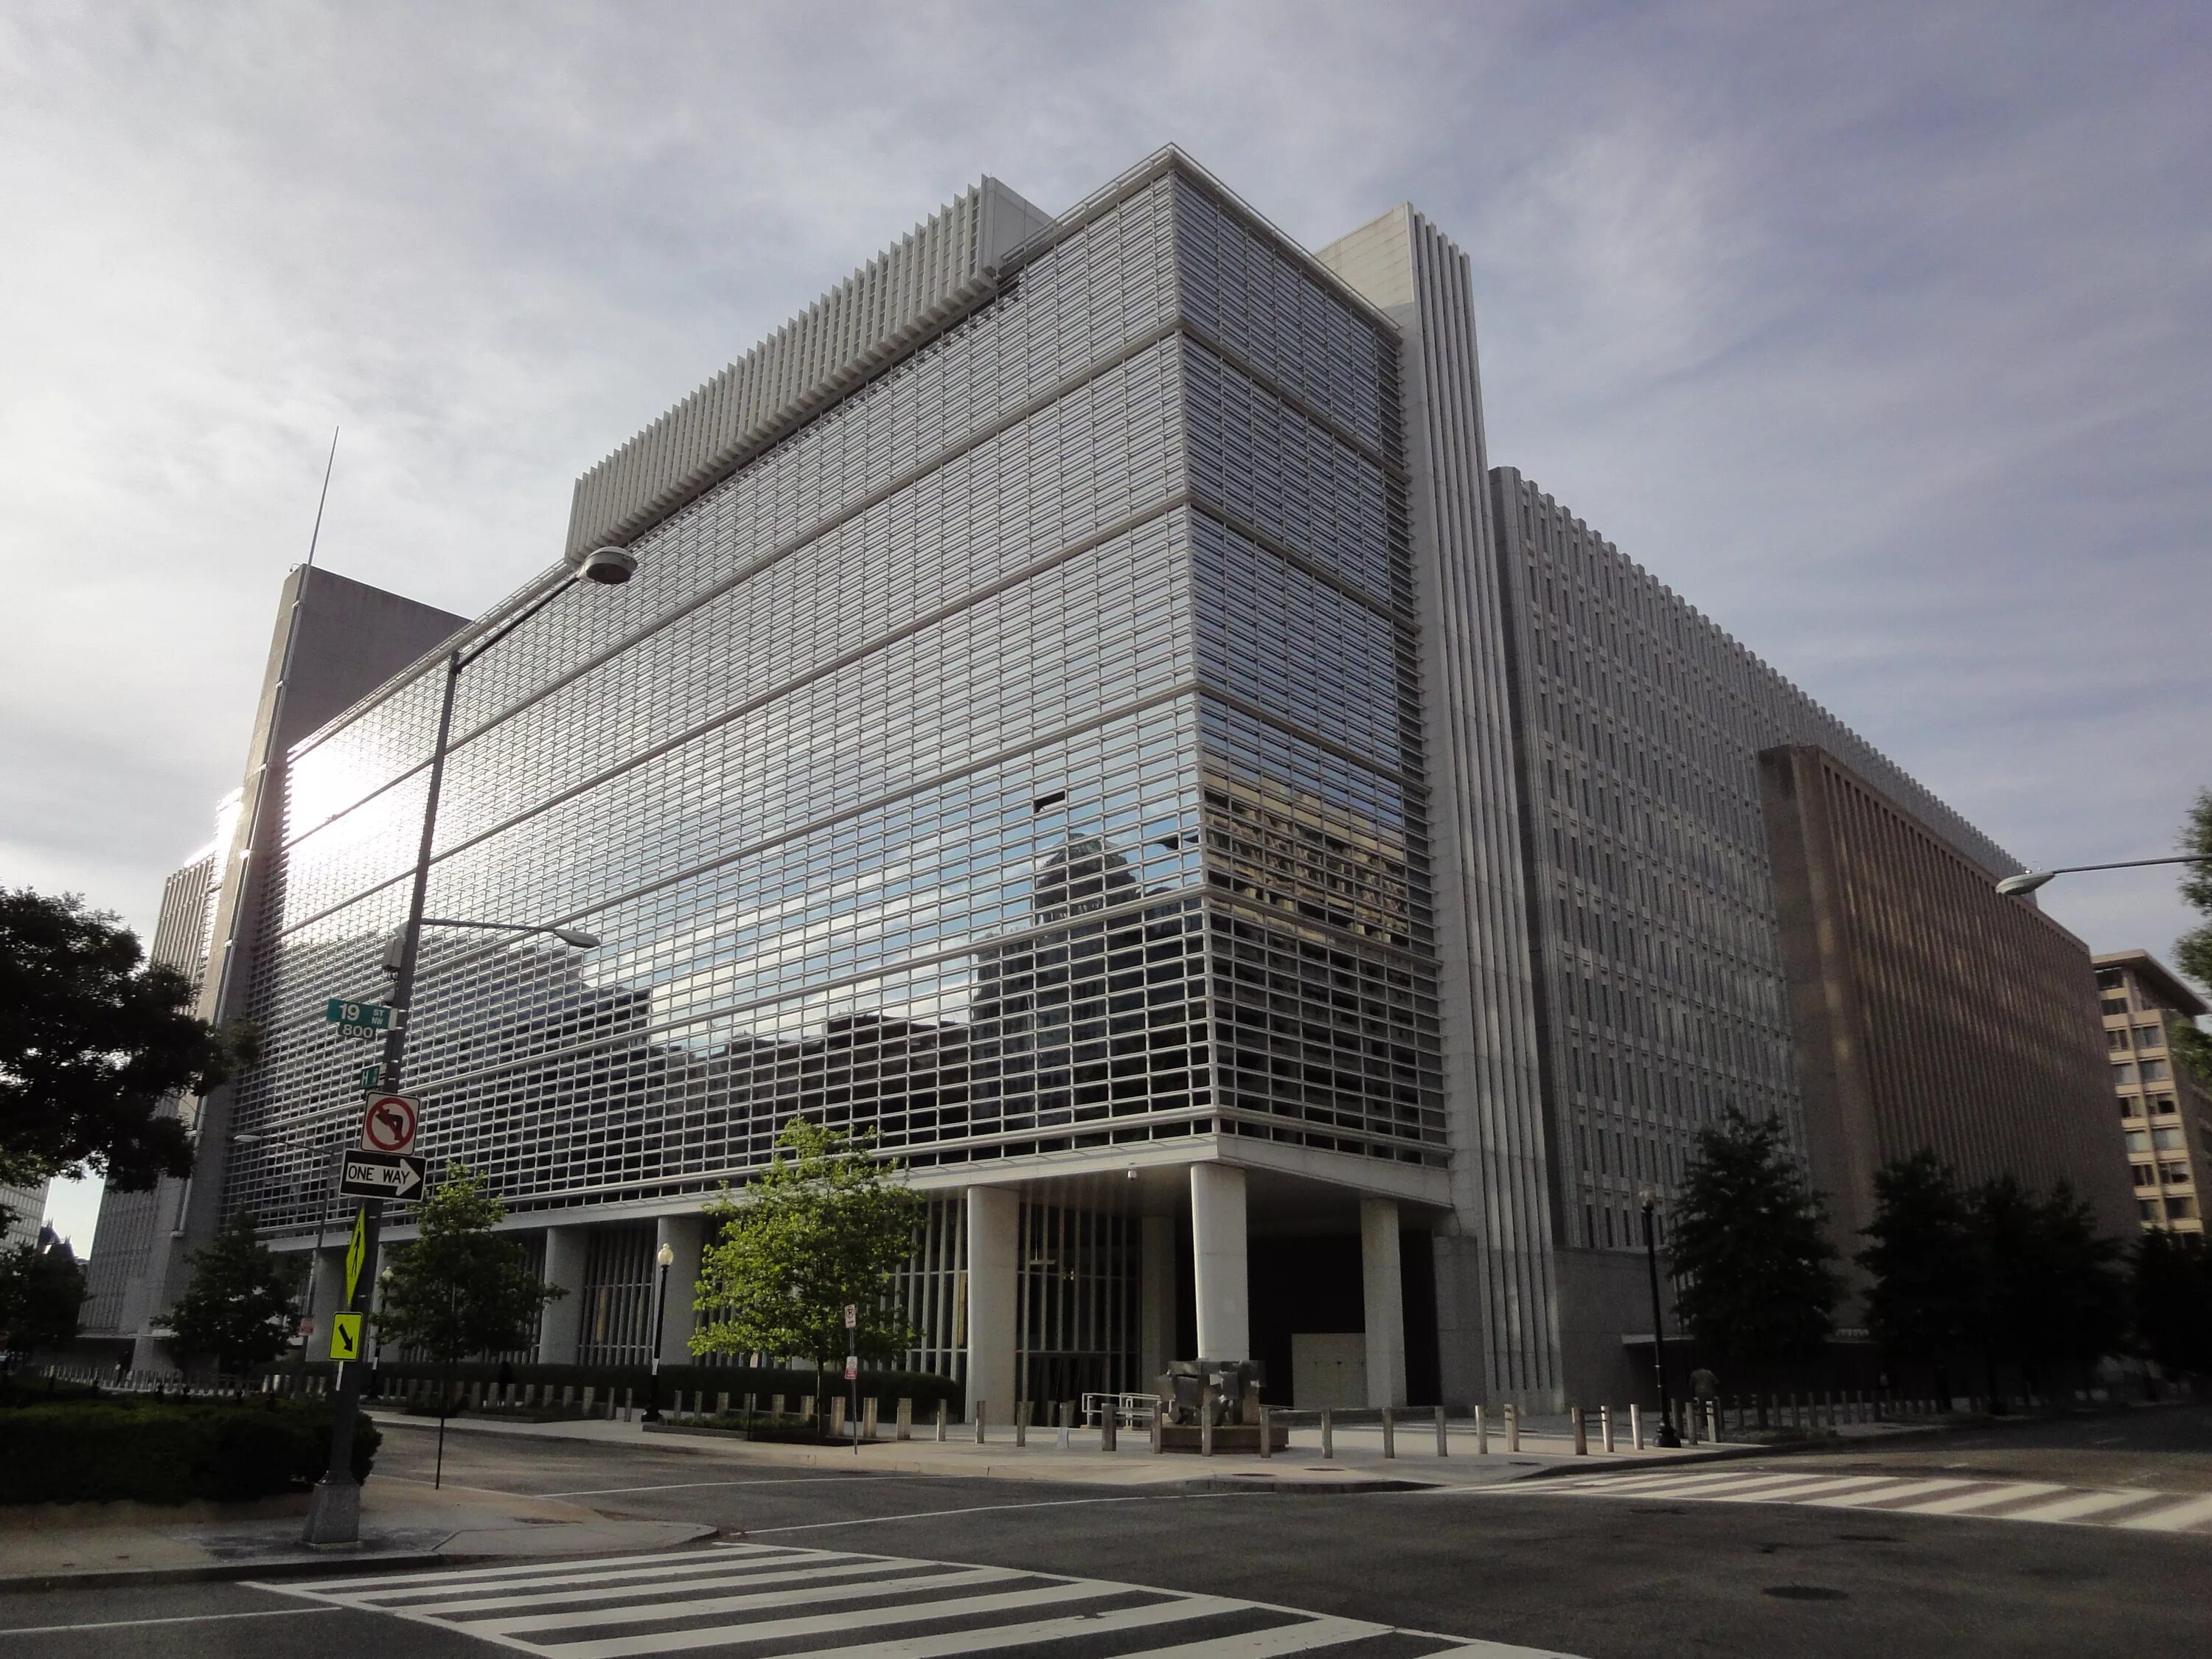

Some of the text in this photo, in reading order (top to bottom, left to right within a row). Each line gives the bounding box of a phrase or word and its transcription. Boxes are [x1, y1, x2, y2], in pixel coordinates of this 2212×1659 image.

[339, 1004, 384, 1020] 19 ST
[371, 1017, 383, 1025] NW
[342, 1024, 373, 1038] 800
[361, 1070, 369, 1086] H
[348, 1166, 410, 1184] ONE WAY
